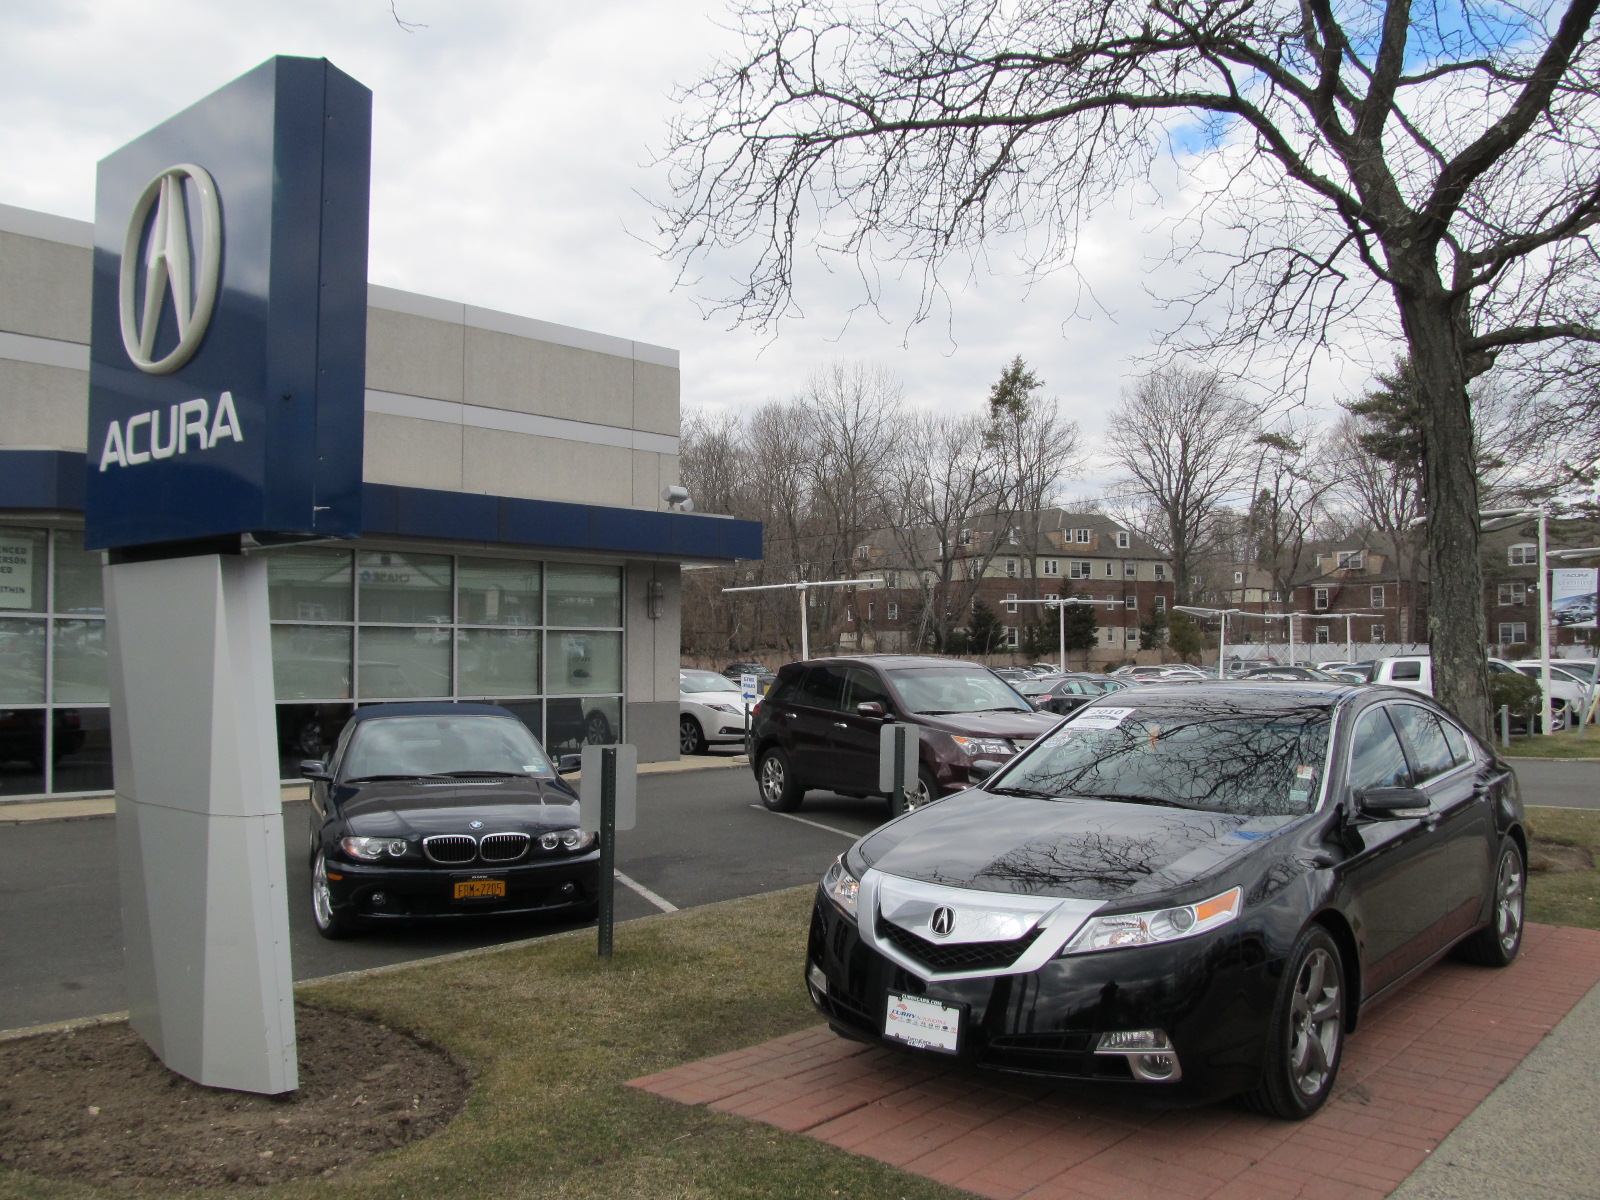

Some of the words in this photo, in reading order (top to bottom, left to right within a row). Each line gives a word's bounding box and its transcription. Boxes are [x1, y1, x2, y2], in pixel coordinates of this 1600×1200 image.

[99, 391, 244, 472] ACURA
[0, 546, 27, 554] NCED
[891, 1009, 917, 1019] CURRY
